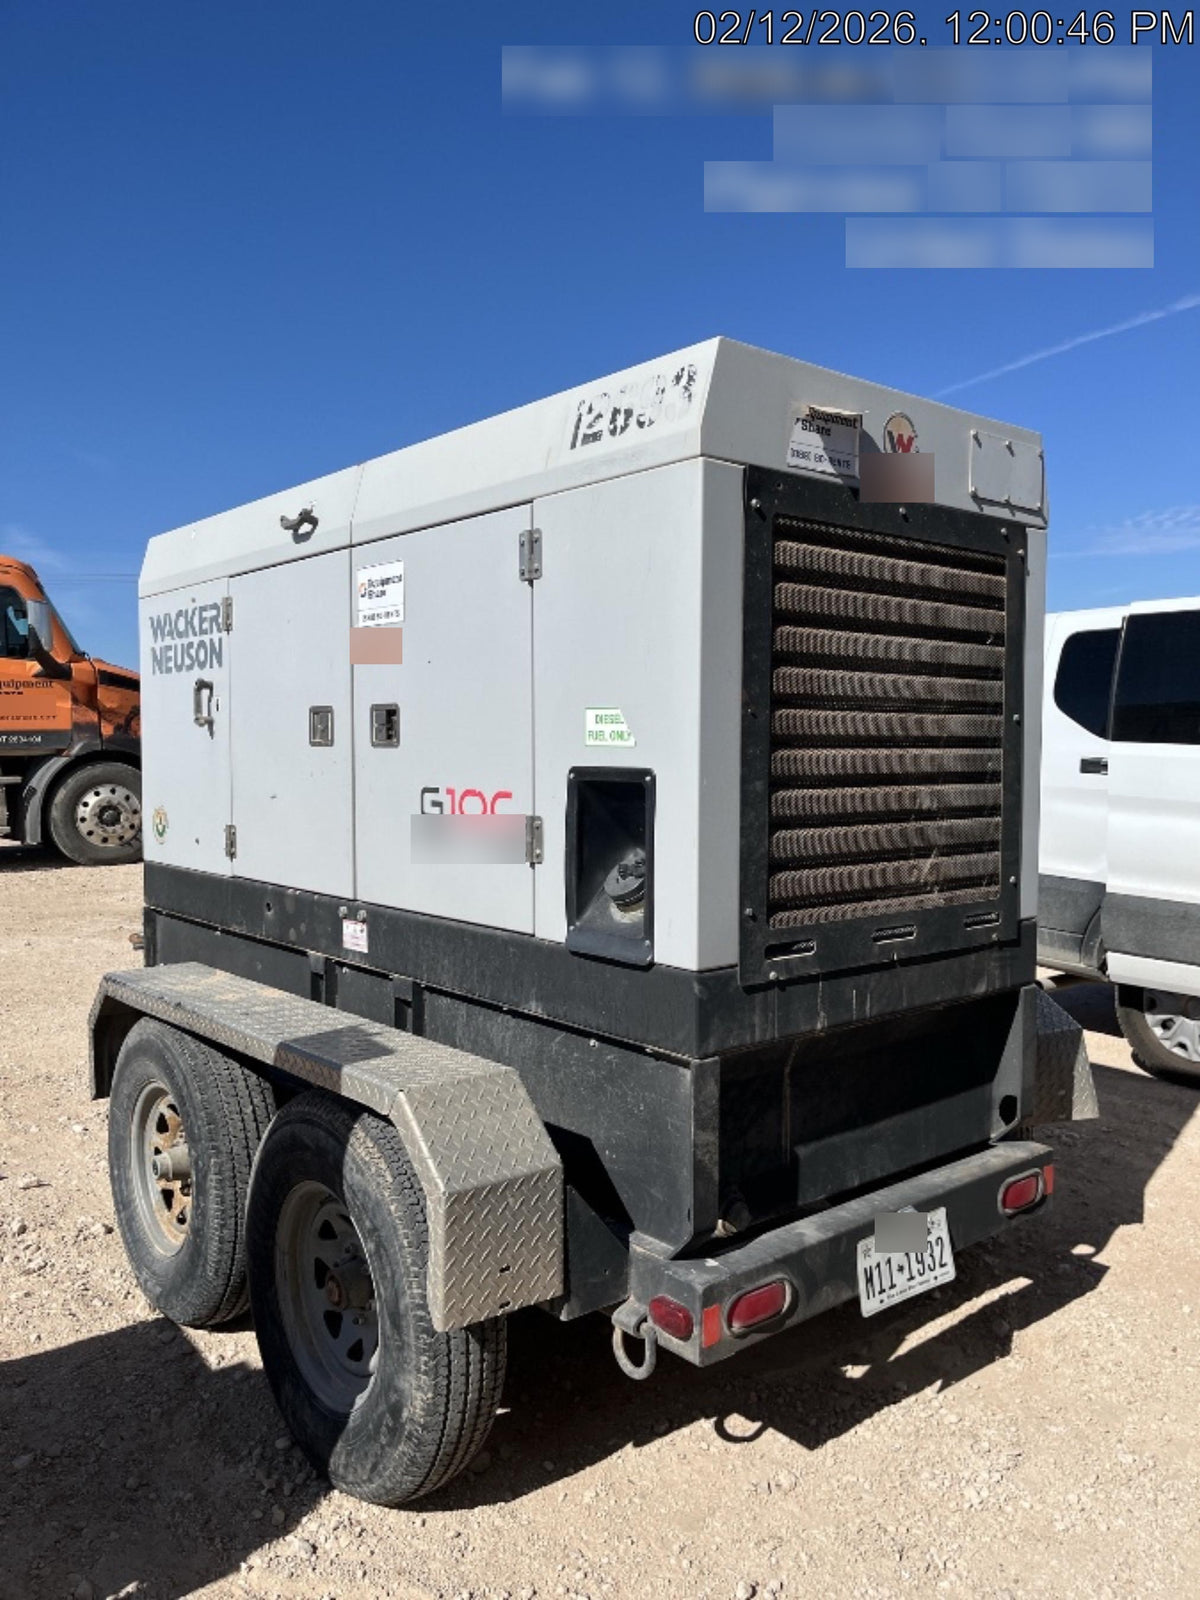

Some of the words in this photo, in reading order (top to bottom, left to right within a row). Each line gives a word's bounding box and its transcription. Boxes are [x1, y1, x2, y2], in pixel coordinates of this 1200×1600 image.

[801, 420, 831, 437] Share
[149, 602, 222, 643] WACKER
[151, 636, 223, 676] NEUSON
